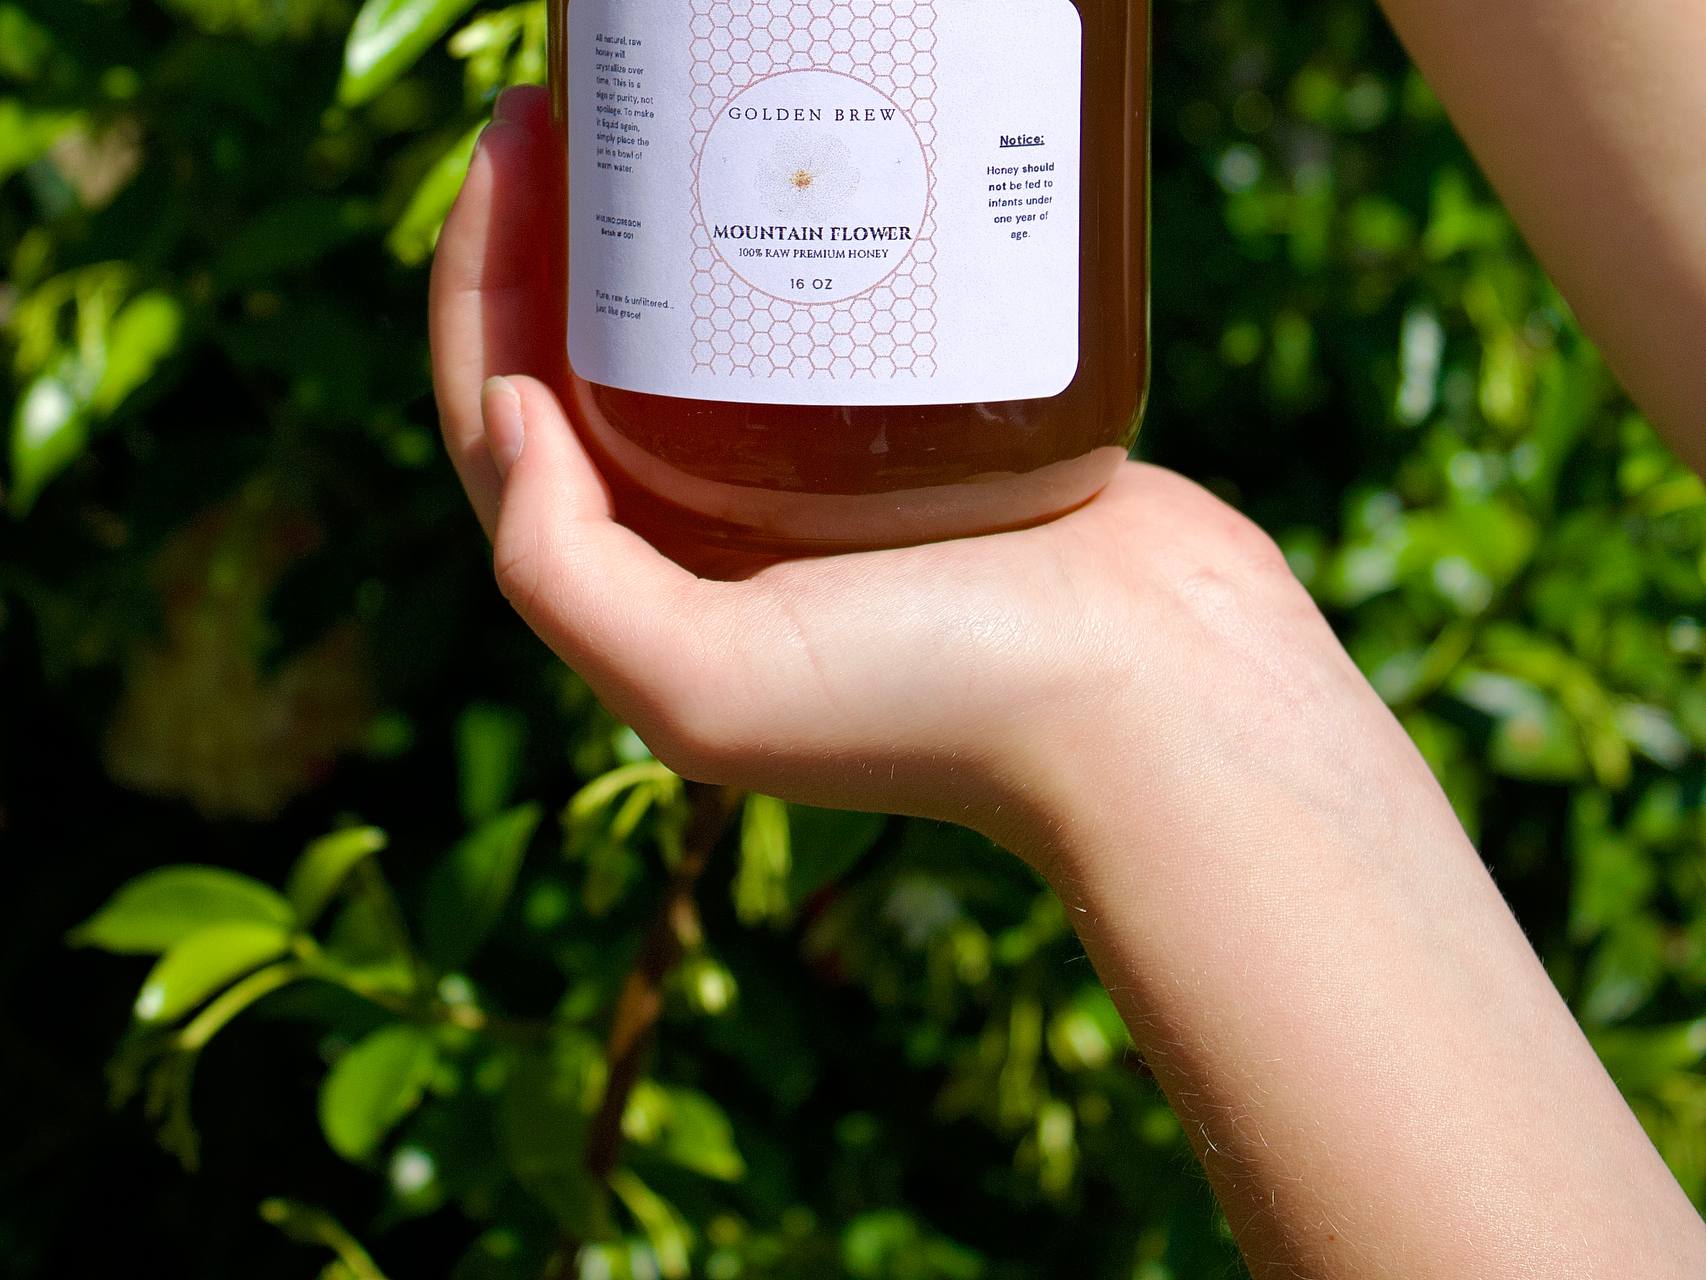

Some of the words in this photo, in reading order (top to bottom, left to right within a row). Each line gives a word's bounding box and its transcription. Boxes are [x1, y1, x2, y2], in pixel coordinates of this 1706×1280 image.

[628, 67, 643, 75] over
[628, 79, 635, 88] is
[617, 94, 639, 104] purity,
[640, 96, 654, 105] not
[624, 107, 633, 116] To
[634, 109, 654, 119] make
[728, 107, 822, 121] GOLDEN
[835, 108, 896, 121] BREW
[617, 136, 635, 145] place
[637, 137, 650, 146] the
[999, 134, 1045, 148] Notice:
[618, 149, 634, 159] bowl
[635, 151, 643, 160] of
[987, 166, 1019, 176] Honey
[1022, 162, 1055, 173] should
[988, 182, 1006, 191] not
[1009, 181, 1022, 190] be
[1025, 179, 1041, 189] fed
[1044, 180, 1053, 188] to
[988, 198, 1023, 207] infants
[1026, 195, 1053, 205] under
[994, 215, 1012, 224] one
[1015, 213, 1036, 224] year
[1039, 211, 1049, 220] of
[713, 224, 824, 241] MOUNTAIN
[830, 226, 912, 241] FLOWER
[1010, 230, 1031, 241] age.
[739, 247, 763, 258] 100%
[765, 249, 790, 258] RAW
[793, 249, 845, 259] PREMIUM
[848, 249, 889, 259] HONEY
[790, 278, 805, 290] 16
[812, 278, 833, 290] OZ
[625, 295, 630, 304] &
